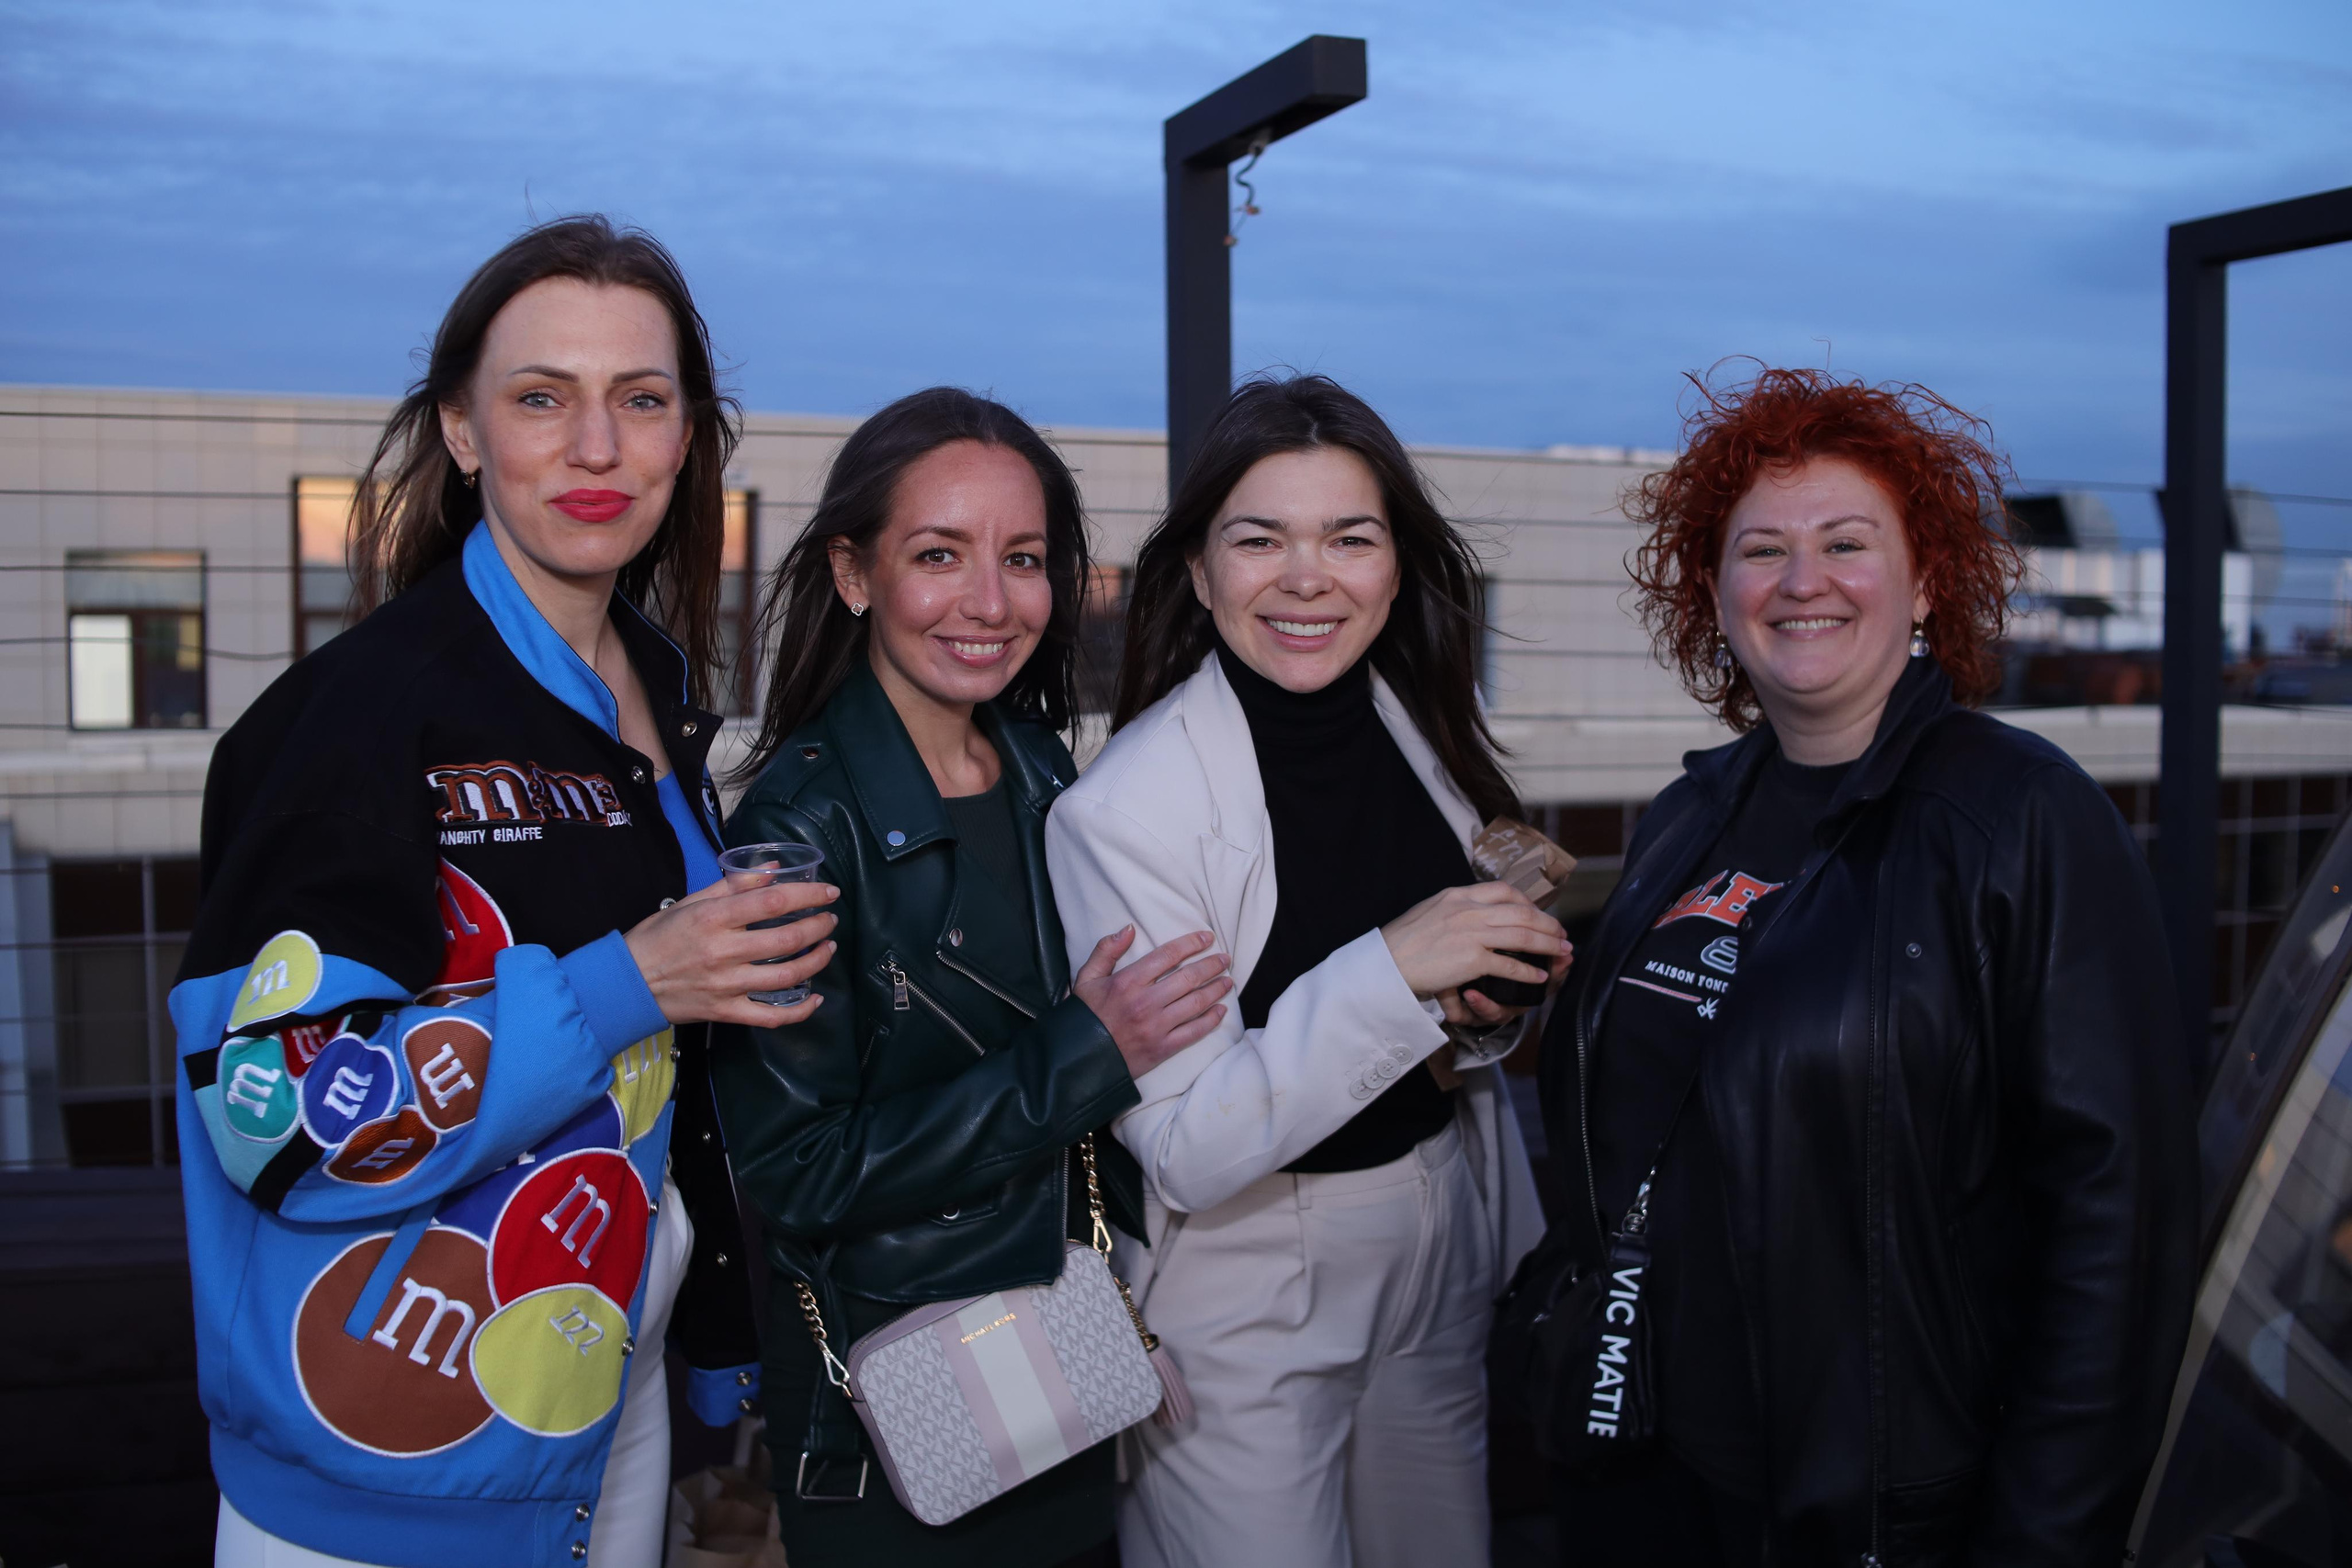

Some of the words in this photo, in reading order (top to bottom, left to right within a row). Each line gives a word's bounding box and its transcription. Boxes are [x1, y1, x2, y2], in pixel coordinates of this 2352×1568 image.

[492, 826, 543, 843] GIRAFFE
[1644, 960, 1695, 985] MAISON
[1605, 1267, 1644, 1325] VIC
[960, 1324, 994, 1345] MICHAEL
[994, 1312, 1017, 1327] KORS
[1587, 1334, 1631, 1438] MATIE
